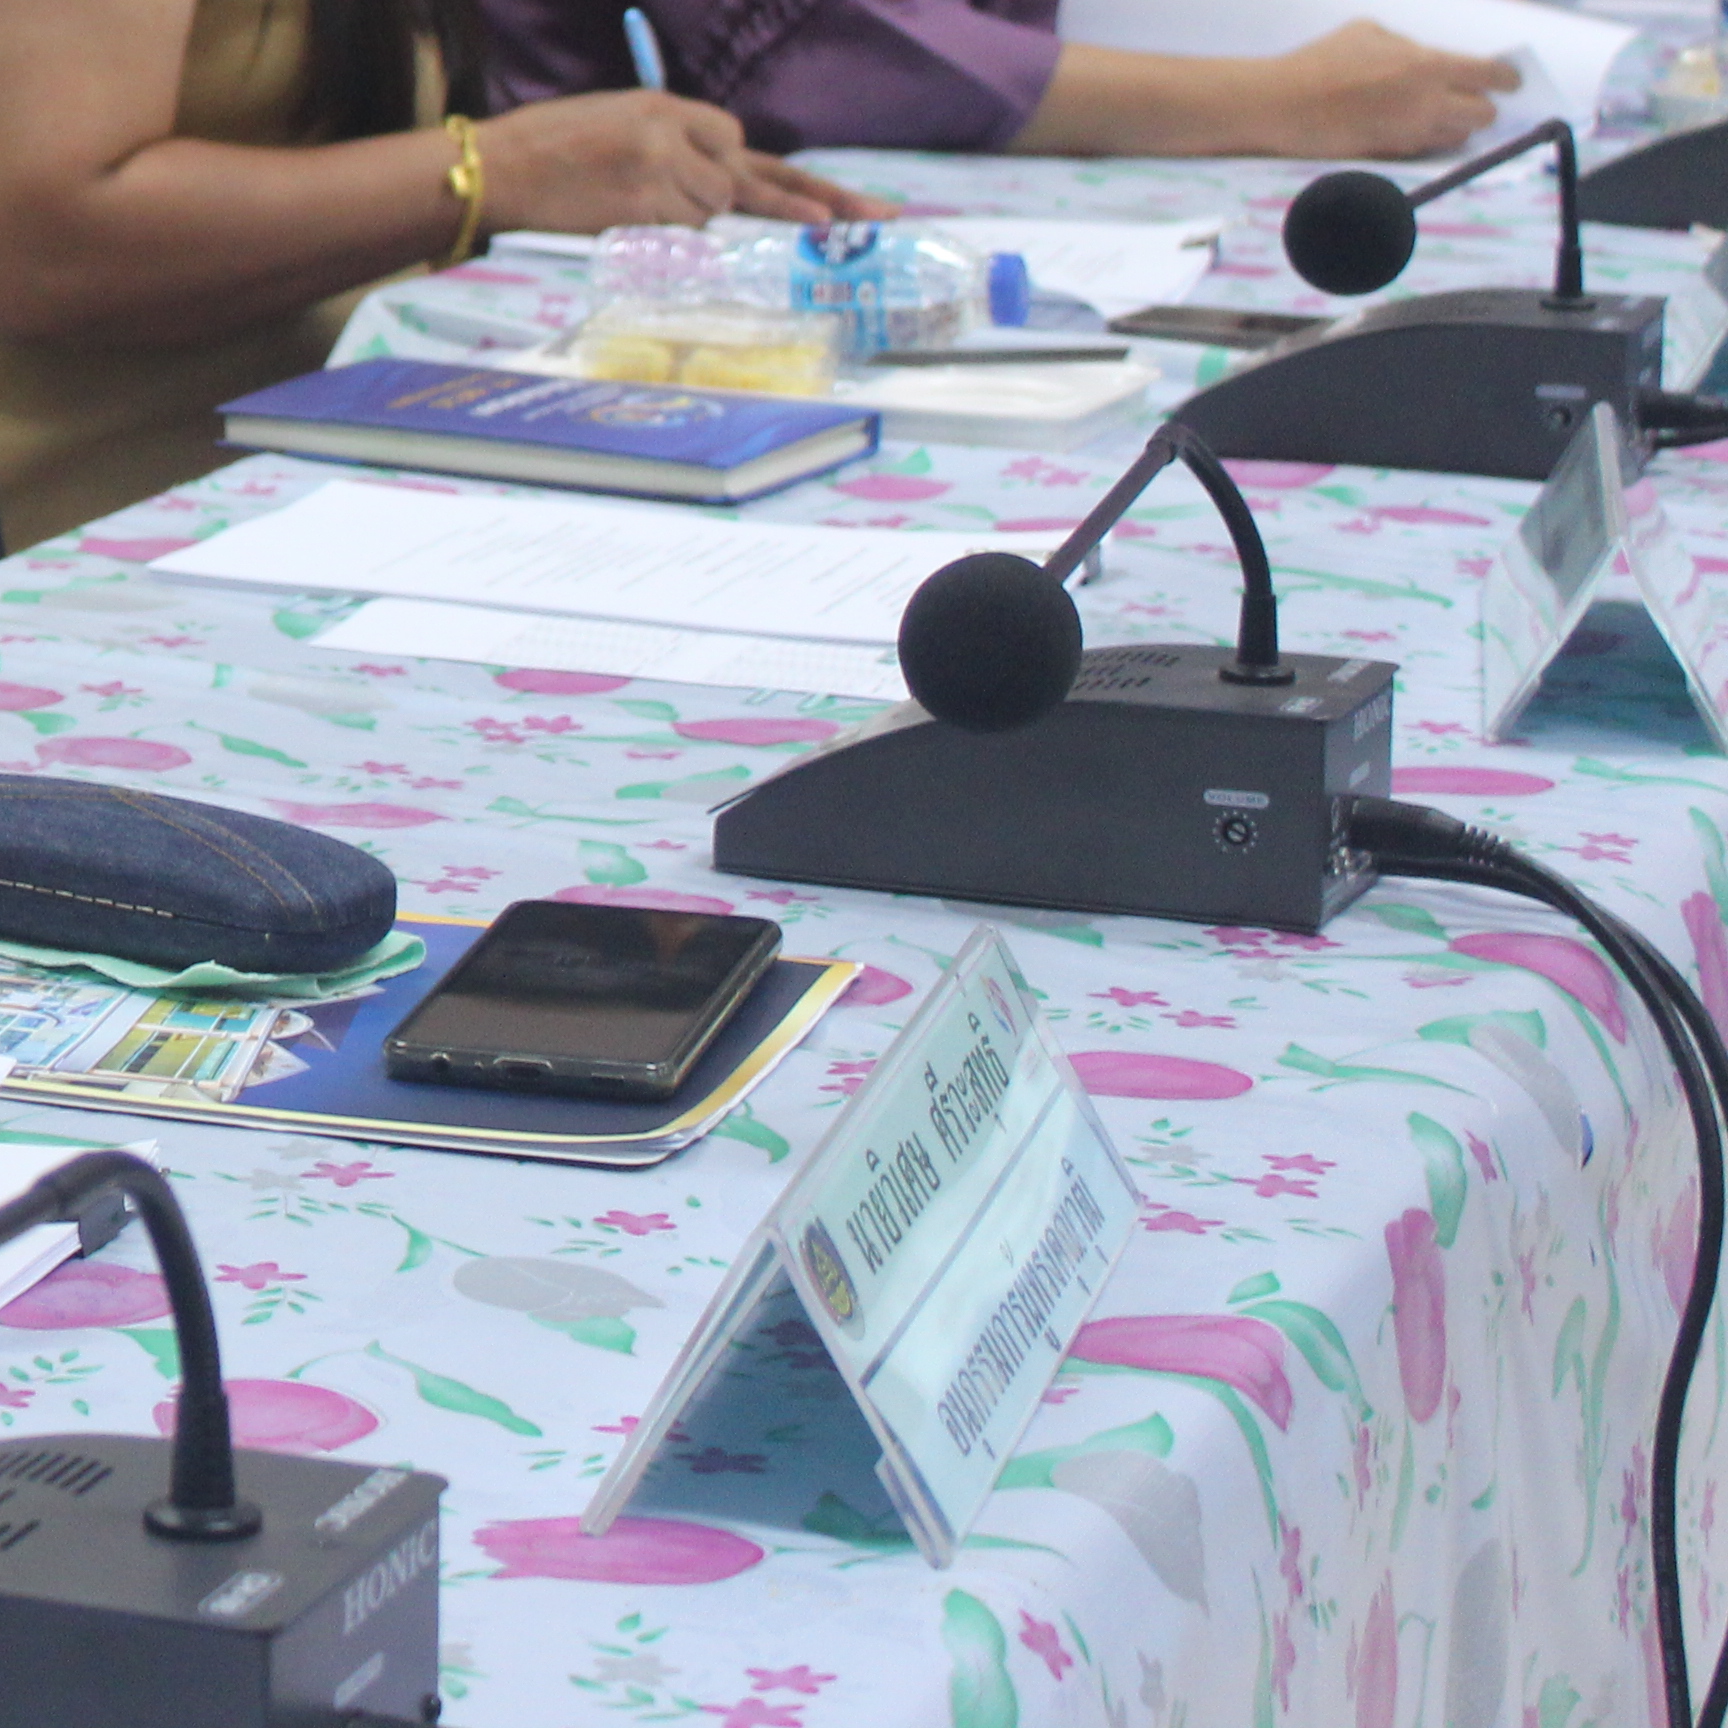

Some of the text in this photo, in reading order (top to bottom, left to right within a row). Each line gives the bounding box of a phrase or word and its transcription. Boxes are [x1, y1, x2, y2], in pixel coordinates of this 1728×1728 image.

[846, 1010, 1010, 1275] นายวิเศษ ศรีวะสุทธิ
[937, 1156, 1109, 1460] อนุกรรมการผู้ทรงคุณวุฒิ
